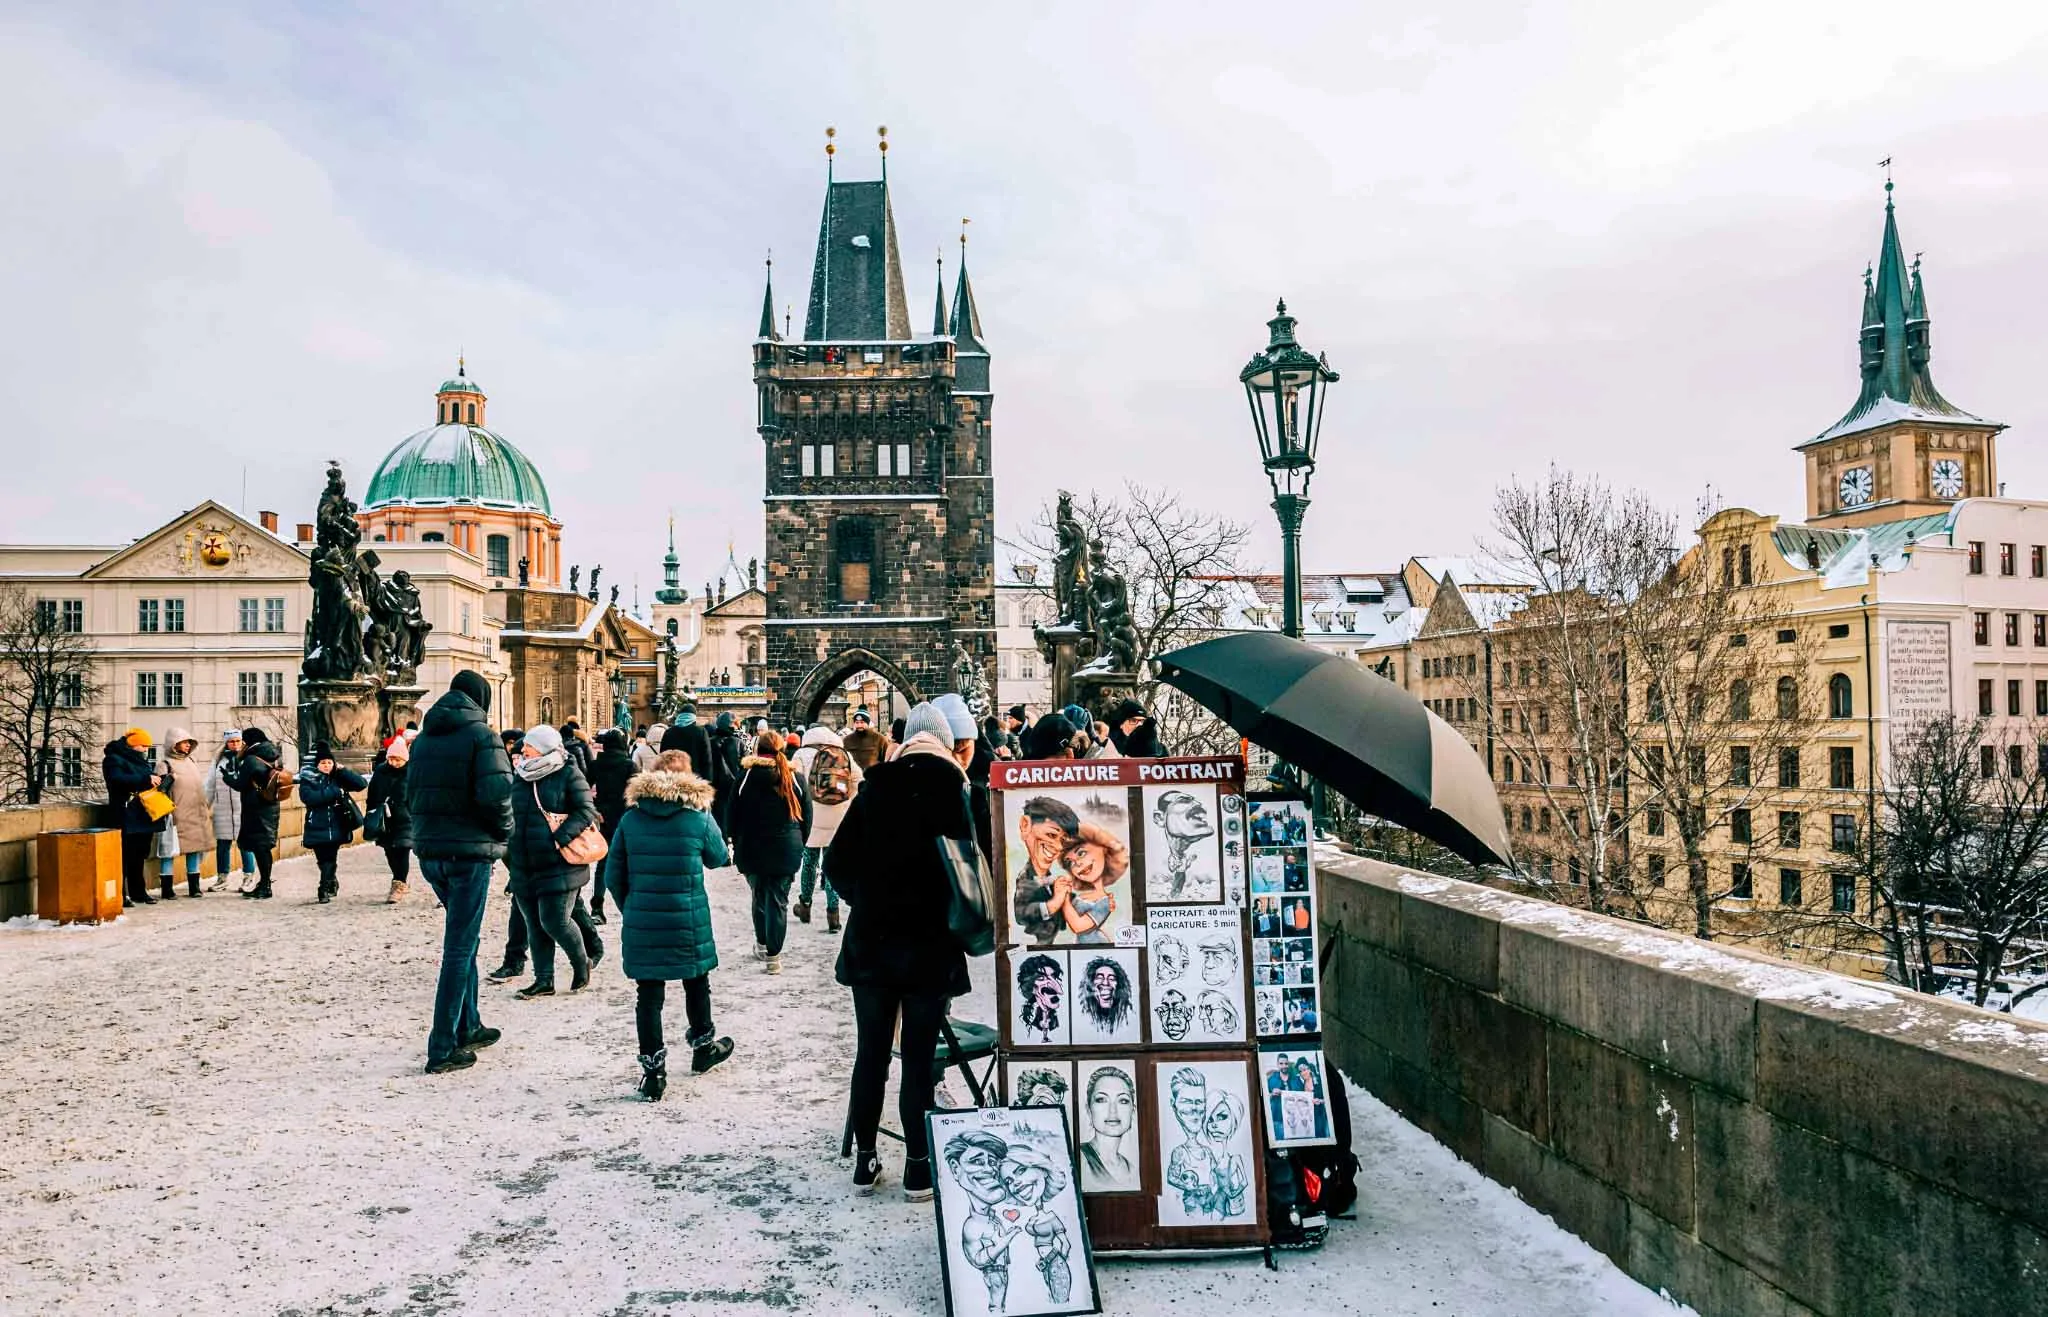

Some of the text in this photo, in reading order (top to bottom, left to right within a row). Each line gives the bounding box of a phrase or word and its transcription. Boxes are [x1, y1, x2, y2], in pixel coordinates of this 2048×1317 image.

[1005, 765, 1120, 784] CARICATURE
[1139, 762, 1235, 780] PORTRAIT
[1150, 908, 1239, 918] PORTRAIT: 40 min.
[1150, 920, 1239, 930] CARICATURE: 5 min.
